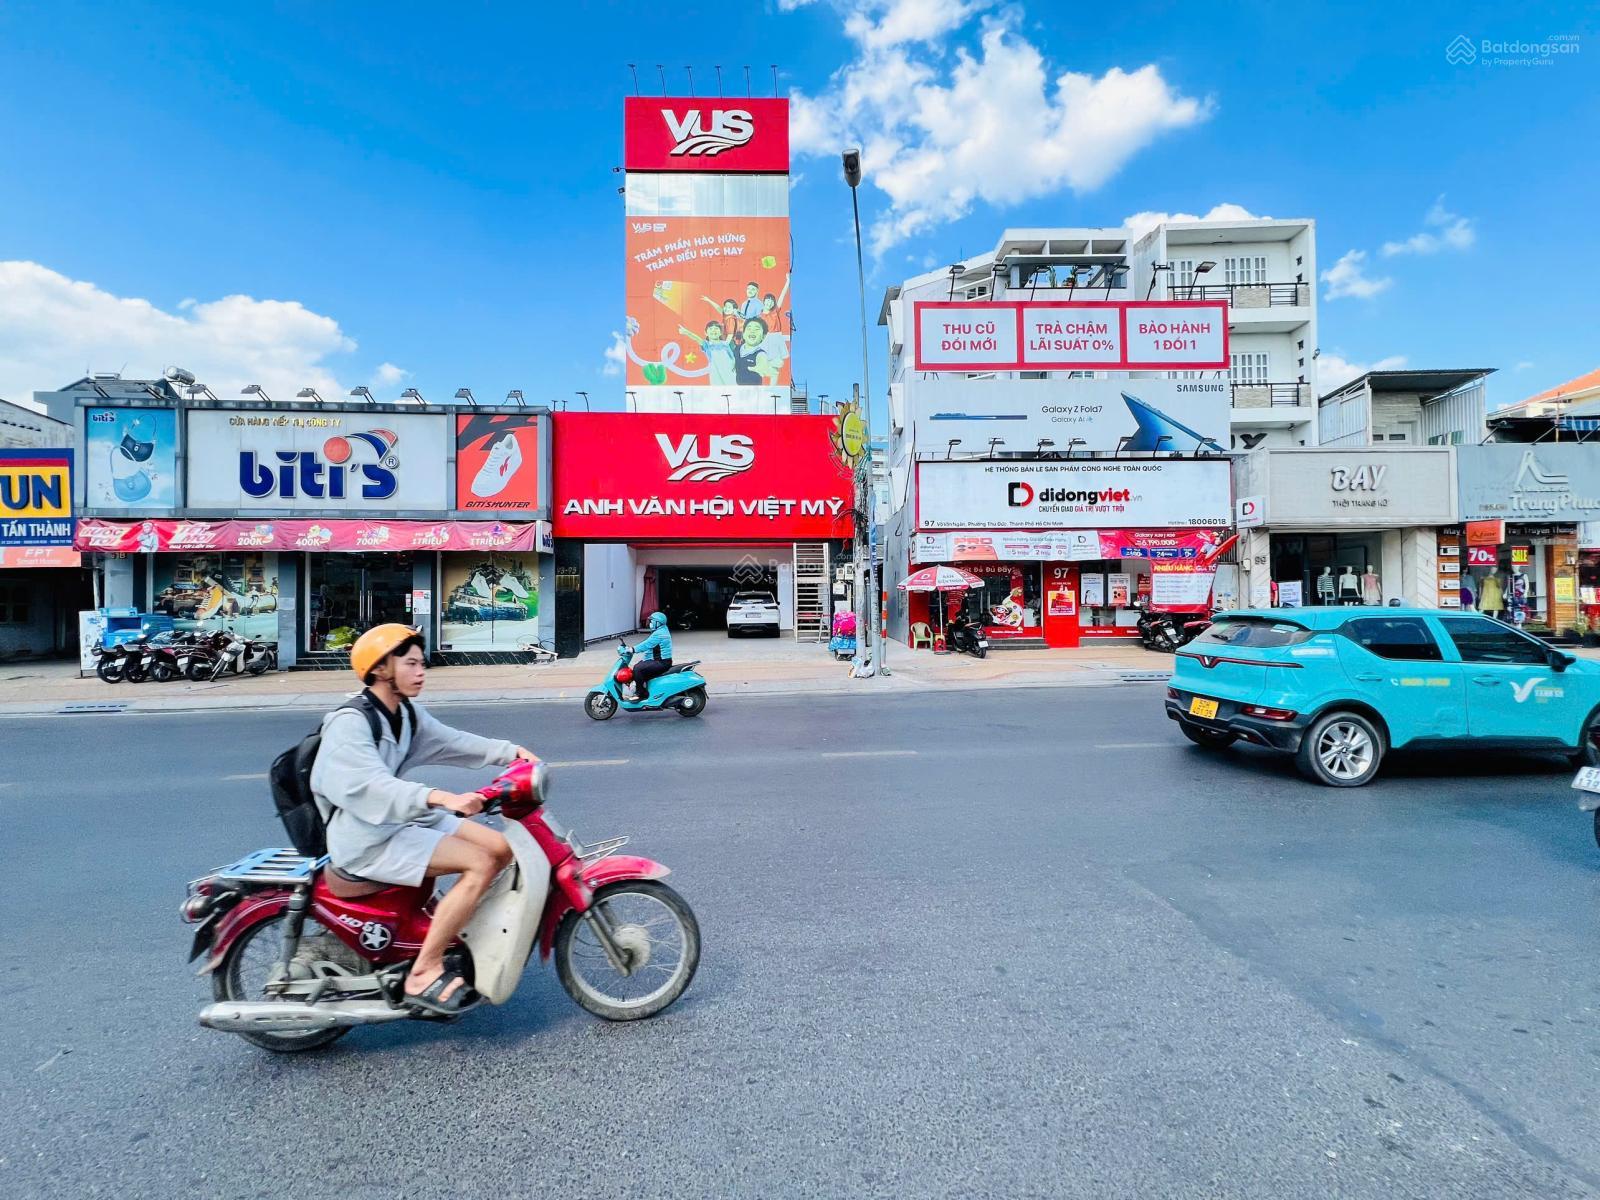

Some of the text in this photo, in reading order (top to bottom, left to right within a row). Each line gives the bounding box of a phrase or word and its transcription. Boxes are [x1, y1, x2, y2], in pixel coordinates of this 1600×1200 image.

[661, 109, 754, 146] VUS
[943, 321, 995, 334] THU CŨ
[1065, 321, 1107, 336] CHẬM
[1171, 320, 1210, 333] HÀNH
[970, 337, 997, 350] MỚI
[1030, 337, 1051, 350] LÃI
[1092, 340, 1114, 350] 0%
[1153, 340, 1159, 350] 1
[1190, 340, 1196, 350] 1
[1177, 384, 1224, 392] SAMSUNG
[1042, 406, 1073, 414] Galaxy
[1051, 416, 1076, 424] Galaxy
[655, 433, 756, 472] VUS
[240, 436, 399, 499] biti's
[1331, 464, 1387, 491] BAY
[563, 495, 844, 520] ANH VĂN HỘI VIỆT MỸ
[29, 521, 71, 537] THÀNH
[237, 537, 264, 546] 200K
[295, 538, 321, 547] 400K
[355, 538, 381, 546] 700K
[25, 549, 54, 557] FPT
[1511, 550, 1528, 562] SALE
[1054, 567, 1069, 579] 97
